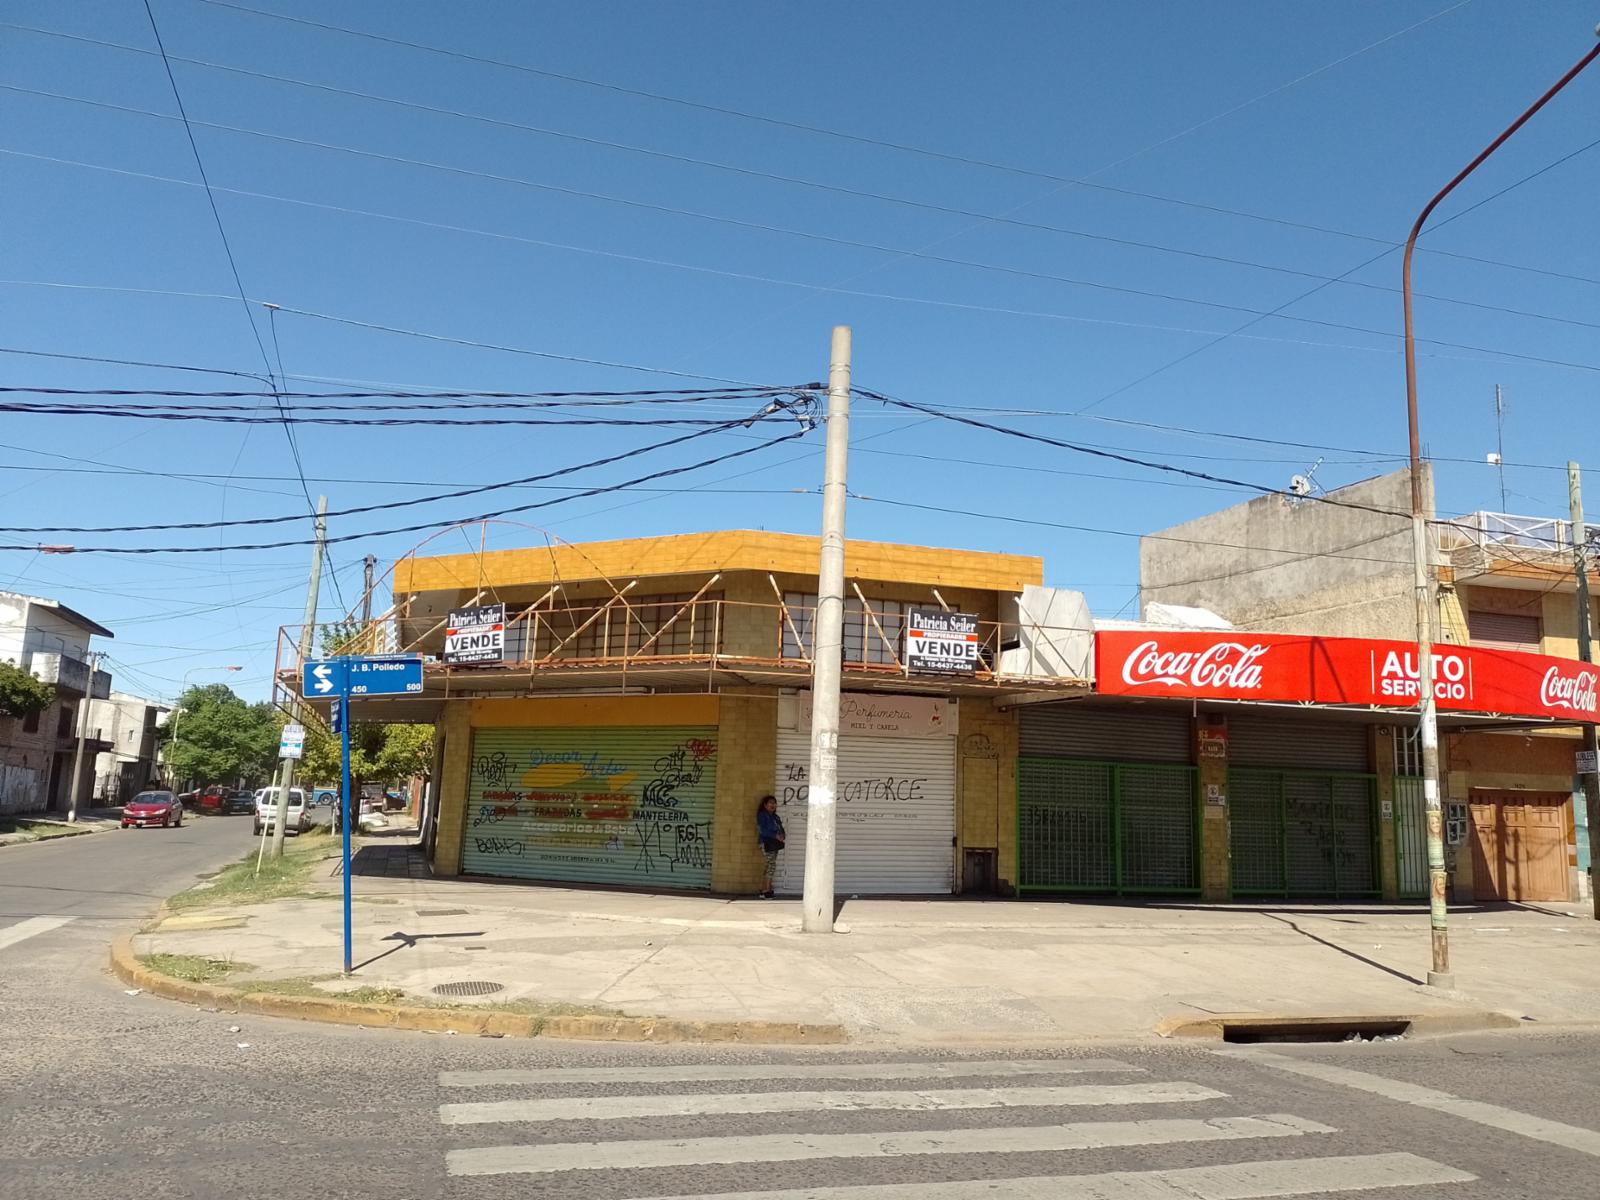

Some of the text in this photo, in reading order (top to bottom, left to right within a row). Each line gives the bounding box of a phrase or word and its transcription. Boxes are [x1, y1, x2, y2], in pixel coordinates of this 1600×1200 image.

[449, 609, 501, 627] Patricia Seiler
[913, 613, 976, 633] Patricia Seiler
[450, 633, 500, 651] VENDE
[916, 640, 975, 657] VENDE
[362, 664, 371, 672] B.
[373, 663, 405, 671] Polledo
[1122, 641, 1271, 689] Coca-Cola
[1381, 651, 1464, 682] AUTO
[351, 685, 367, 693] 450
[1381, 679, 1465, 700] SERCIO
[1540, 666, 1597, 713] Coca-Cola
